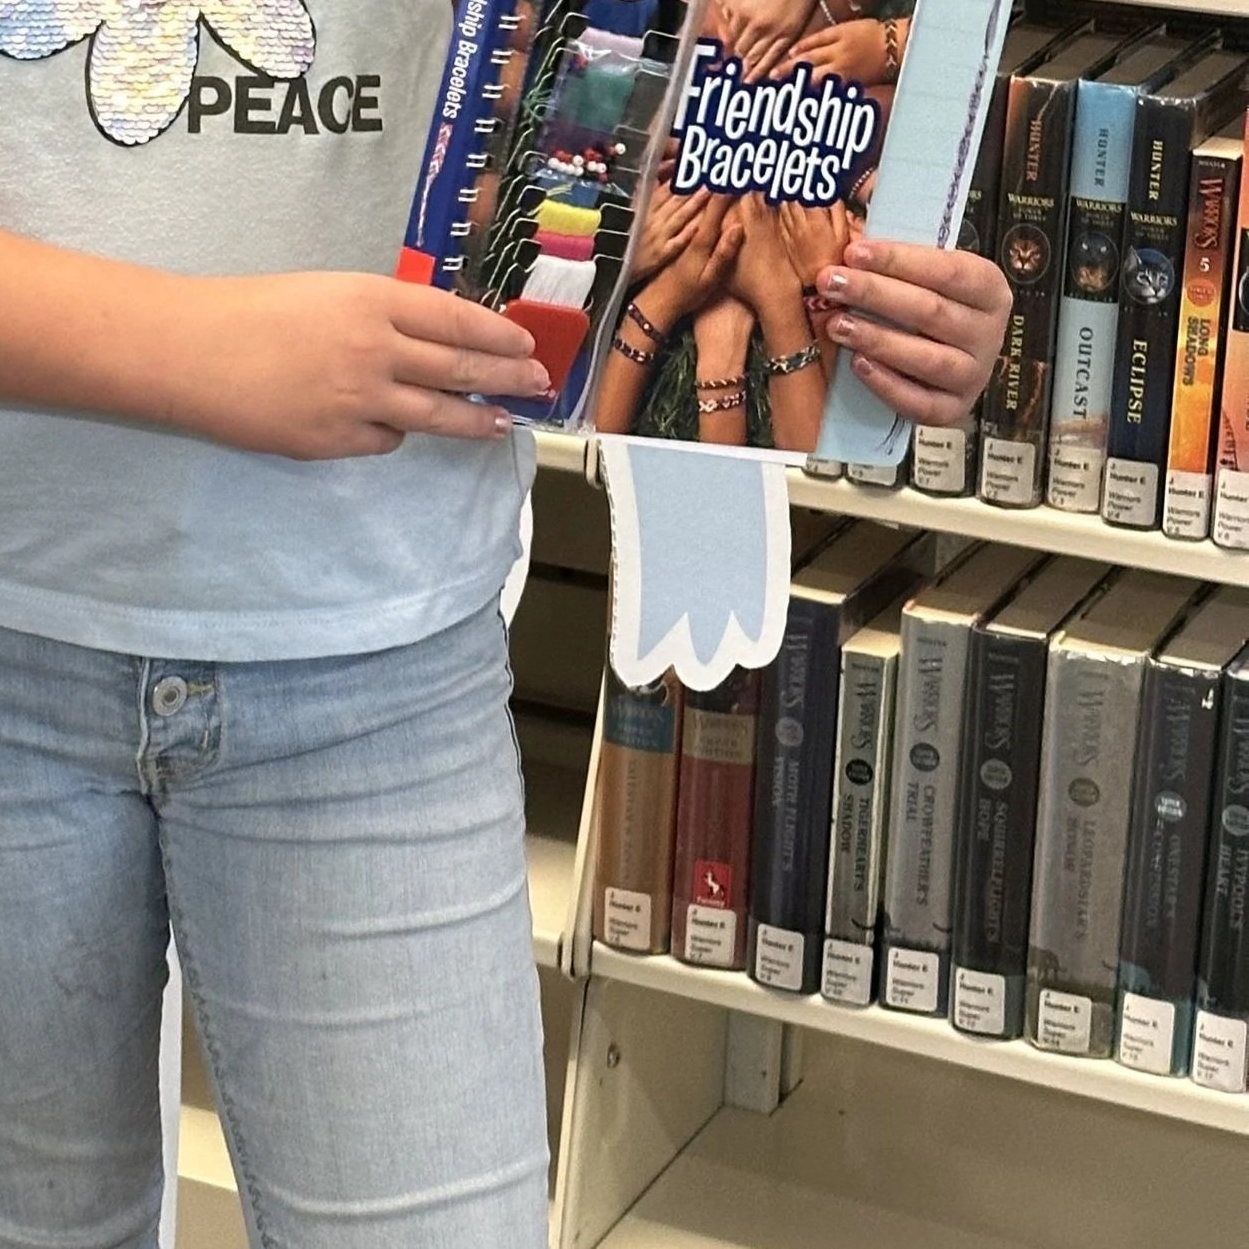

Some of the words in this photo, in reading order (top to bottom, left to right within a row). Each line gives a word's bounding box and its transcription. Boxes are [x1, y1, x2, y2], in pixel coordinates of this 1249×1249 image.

[186, 73, 383, 136] PEACE
[442, 40, 478, 119] Bracelets
[673, 44, 875, 170] Friendship
[675, 124, 841, 200] Bracelets
[1025, 119, 1042, 182] HUNTER
[1094, 128, 1109, 187] HUNTER
[1148, 140, 1164, 200] HUNTER
[1007, 193, 1055, 209] WARRIORS
[1075, 199, 1122, 213] WARRIORS
[1130, 211, 1178, 227] WARRIORS
[1008, 314, 1025, 358] DARK
[1182, 316, 1199, 387] SHADOWS
[1198, 318, 1211, 357] LONG
[1006, 362, 1021, 410] RIVER
[1072, 326, 1094, 420] OUTCAST
[1126, 338, 1148, 425] ECLIPSE
